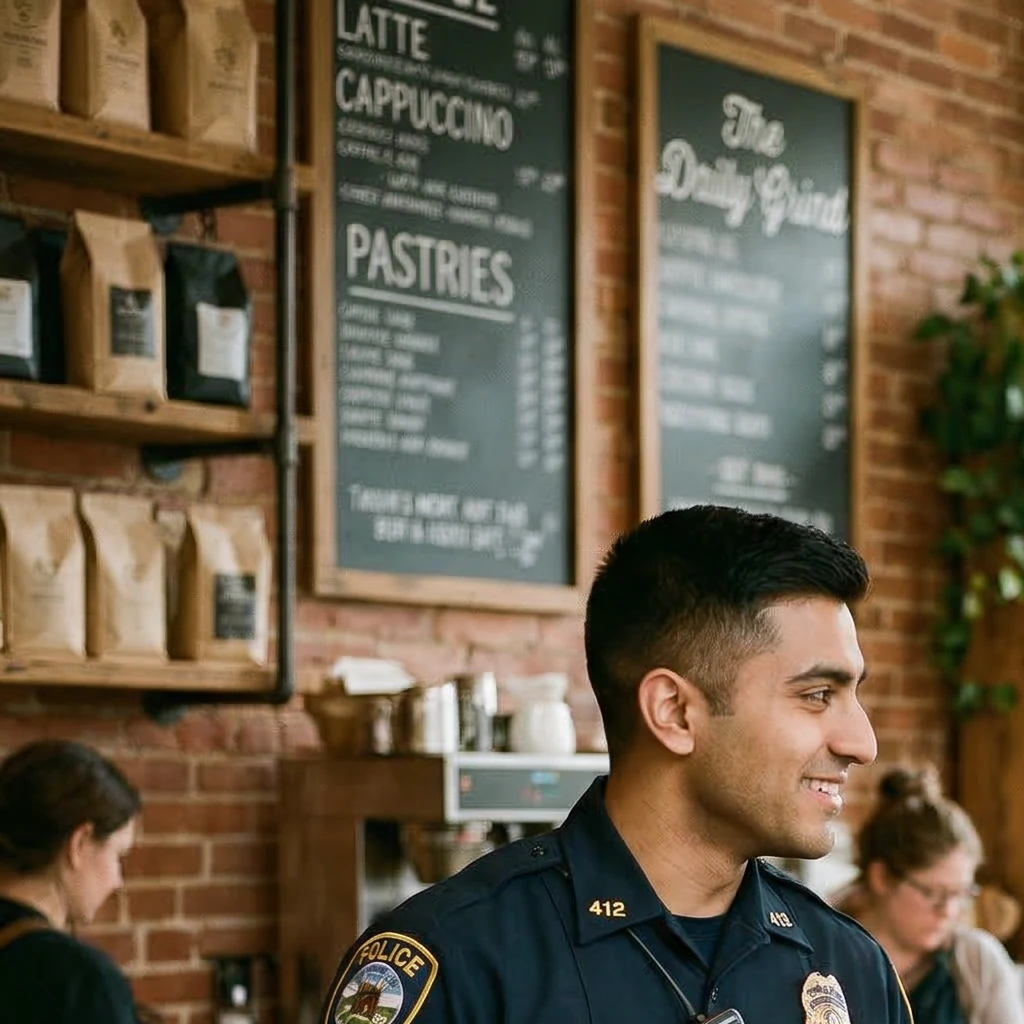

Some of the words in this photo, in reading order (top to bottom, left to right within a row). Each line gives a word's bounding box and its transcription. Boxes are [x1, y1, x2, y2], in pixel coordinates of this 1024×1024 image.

[337, 0, 430, 60] LATTE
[335, 67, 514, 151] CAPPUCCINO
[721, 93, 786, 158] The
[346, 222, 514, 307] PASTRIES
[589, 900, 627, 917] 412
